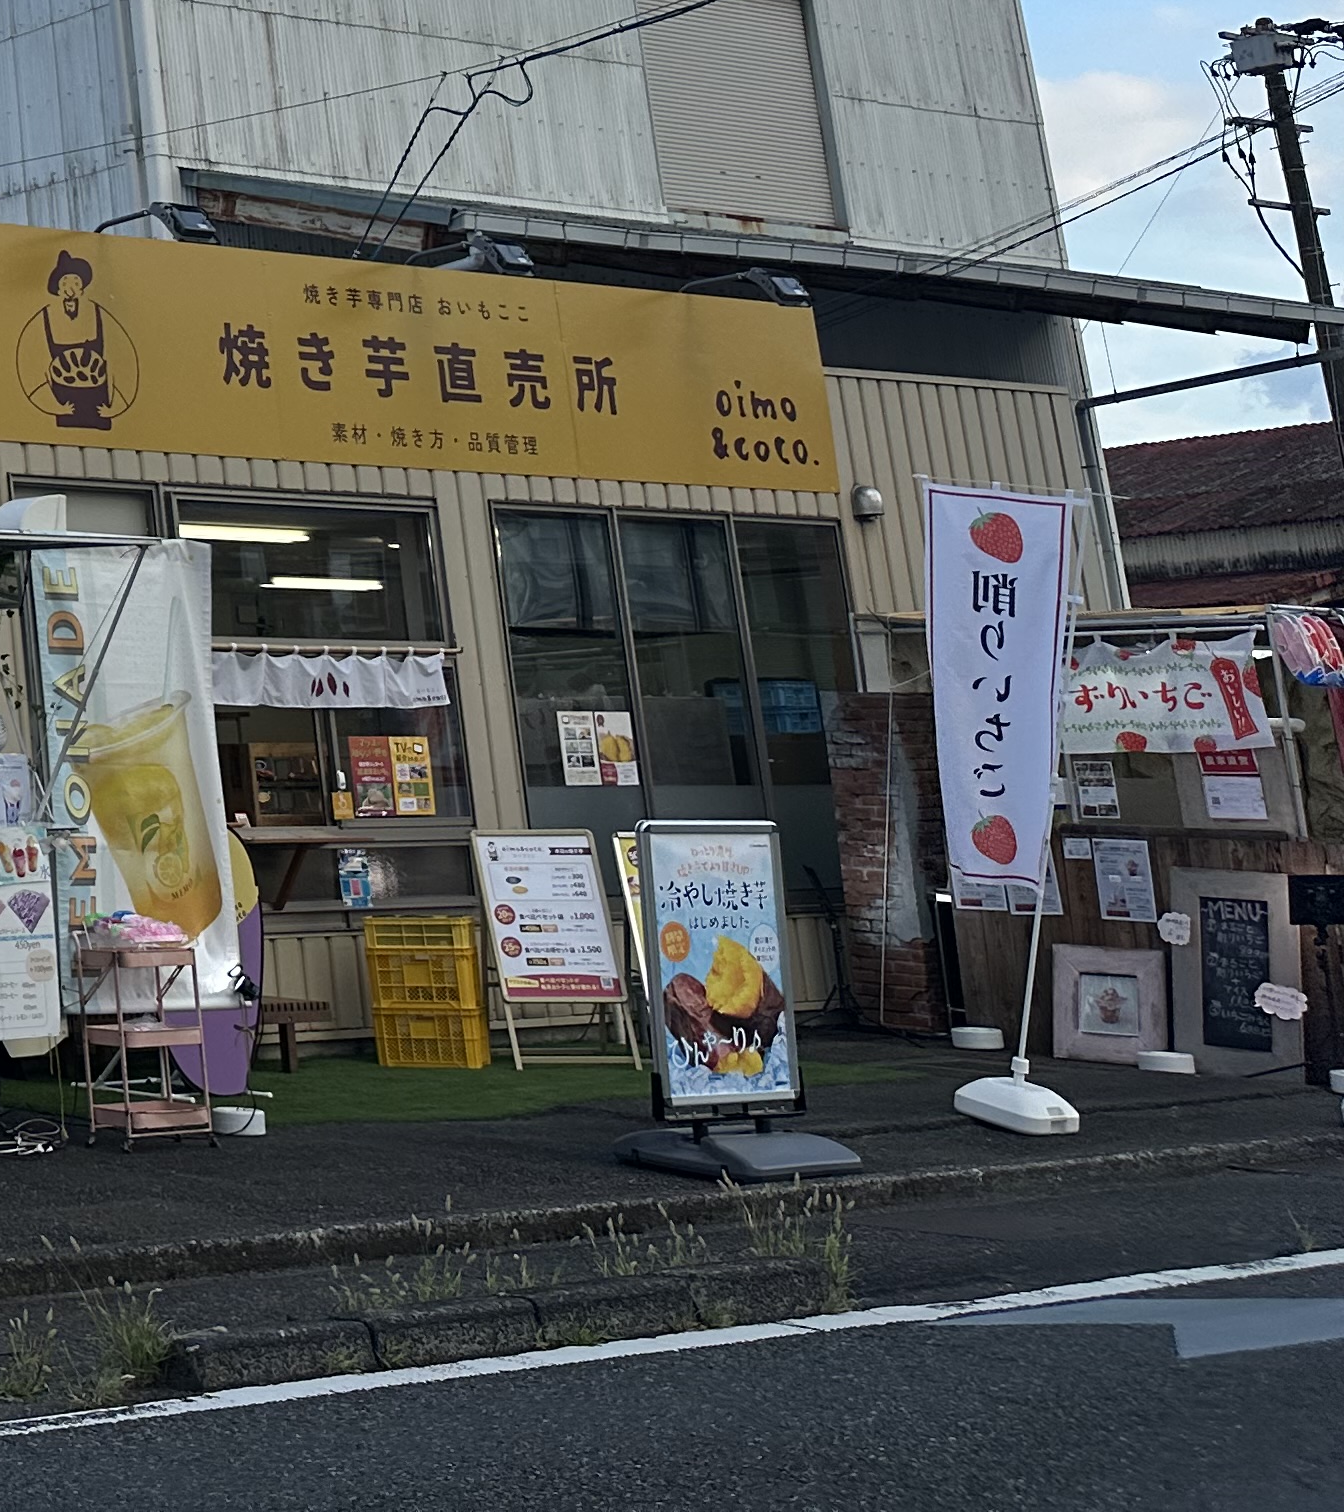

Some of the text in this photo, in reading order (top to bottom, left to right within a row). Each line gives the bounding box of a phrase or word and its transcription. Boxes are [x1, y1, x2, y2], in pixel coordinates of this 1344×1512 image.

[303, 283, 530, 323] 焼き芋専門店 おいもここ
[218, 322, 619, 416] 焼き芋直売所
[715, 379, 797, 422] oimo
[331, 422, 540, 457] 素材・焼き方・品質管理
[1068, 681, 1212, 714] ずりいちご
[42, 565, 103, 978] EMONADE
[659, 879, 768, 912] 冷やし焼き芋
[688, 915, 751, 930] はじめました
